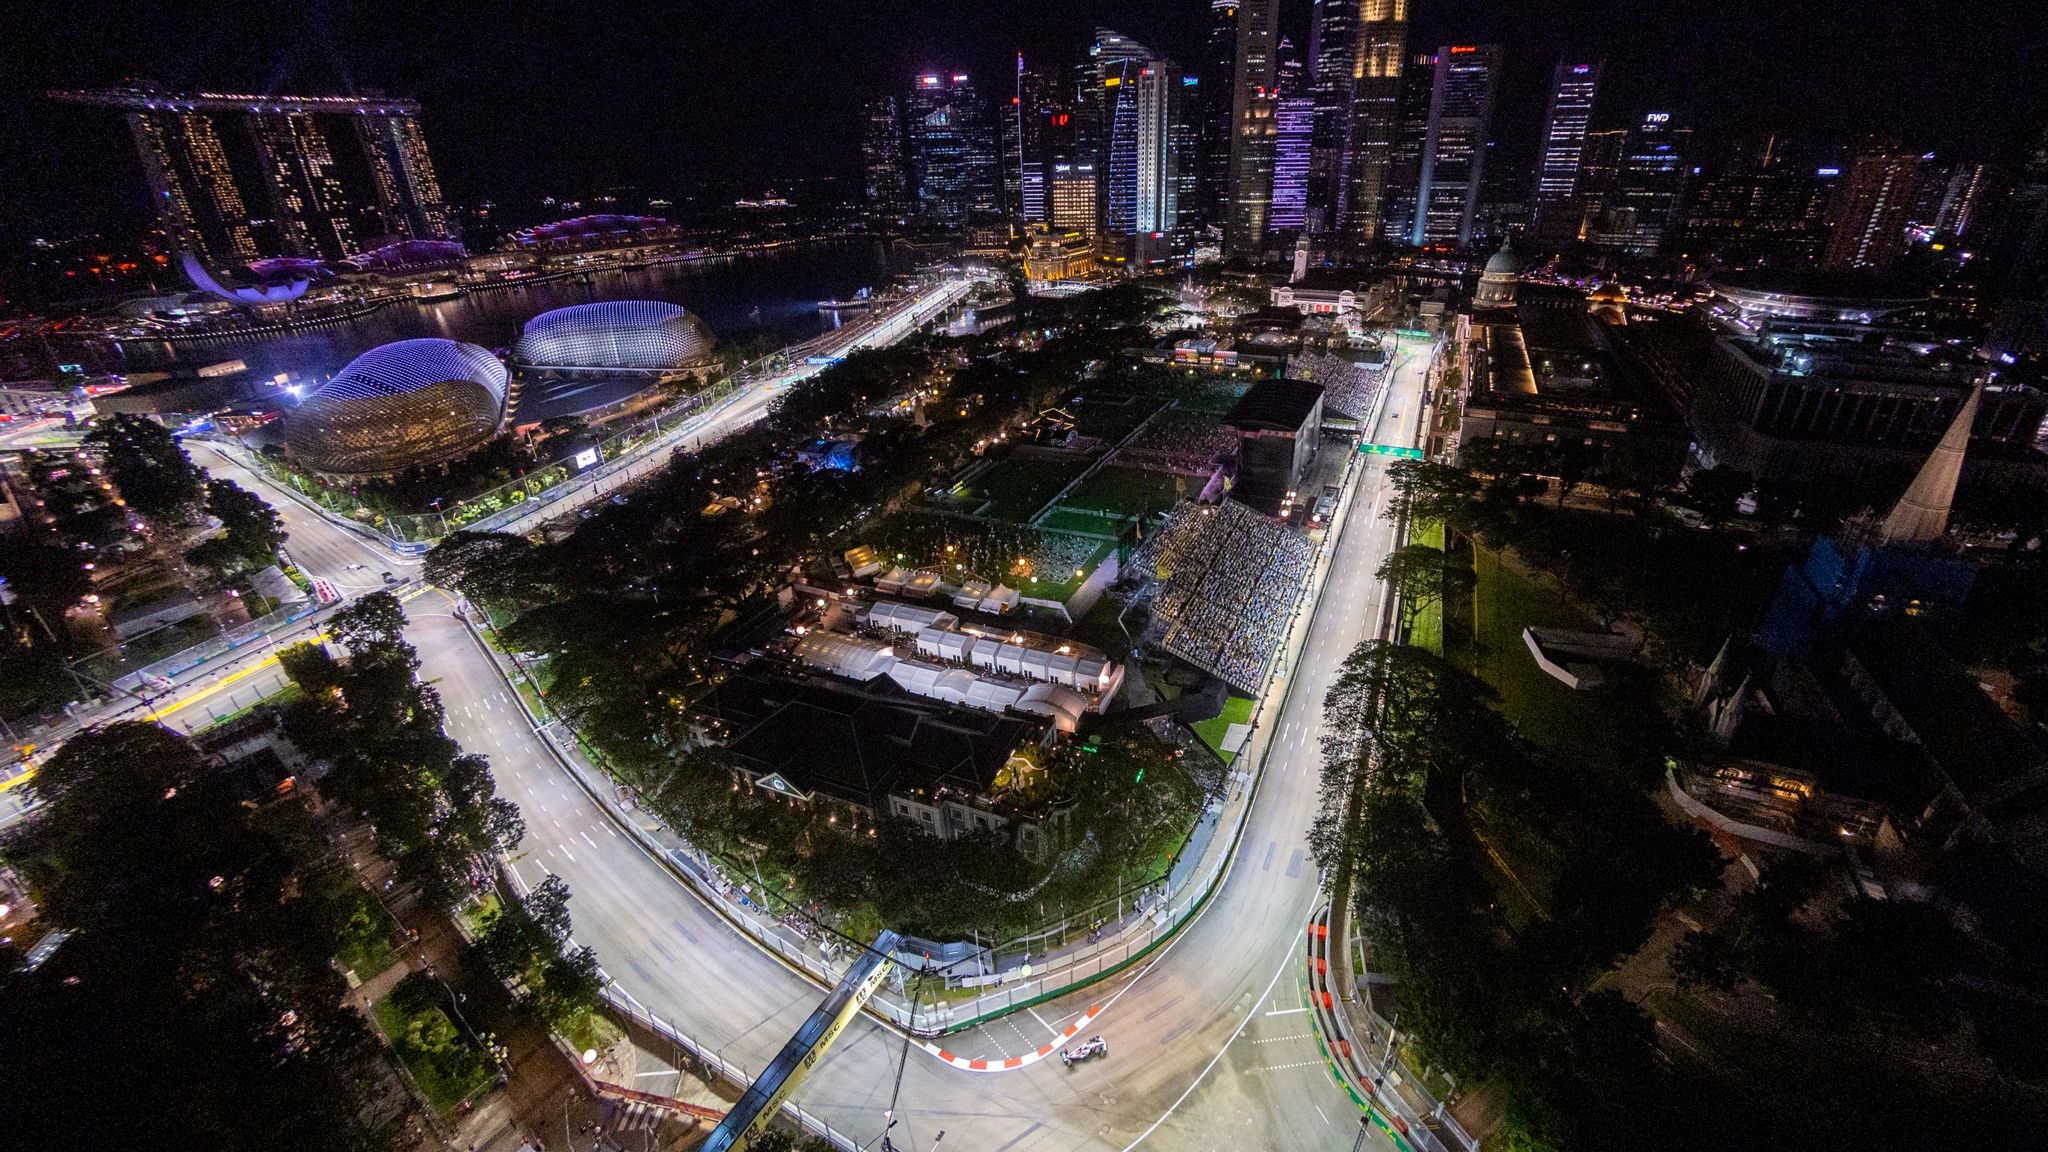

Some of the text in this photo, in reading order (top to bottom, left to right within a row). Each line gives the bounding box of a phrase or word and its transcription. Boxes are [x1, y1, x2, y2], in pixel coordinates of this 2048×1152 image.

[1647, 113, 1669, 122] FWD
[869, 964, 889, 988] MSC
[819, 1021, 841, 1049] MSC
[762, 1089, 787, 1120] MSC
